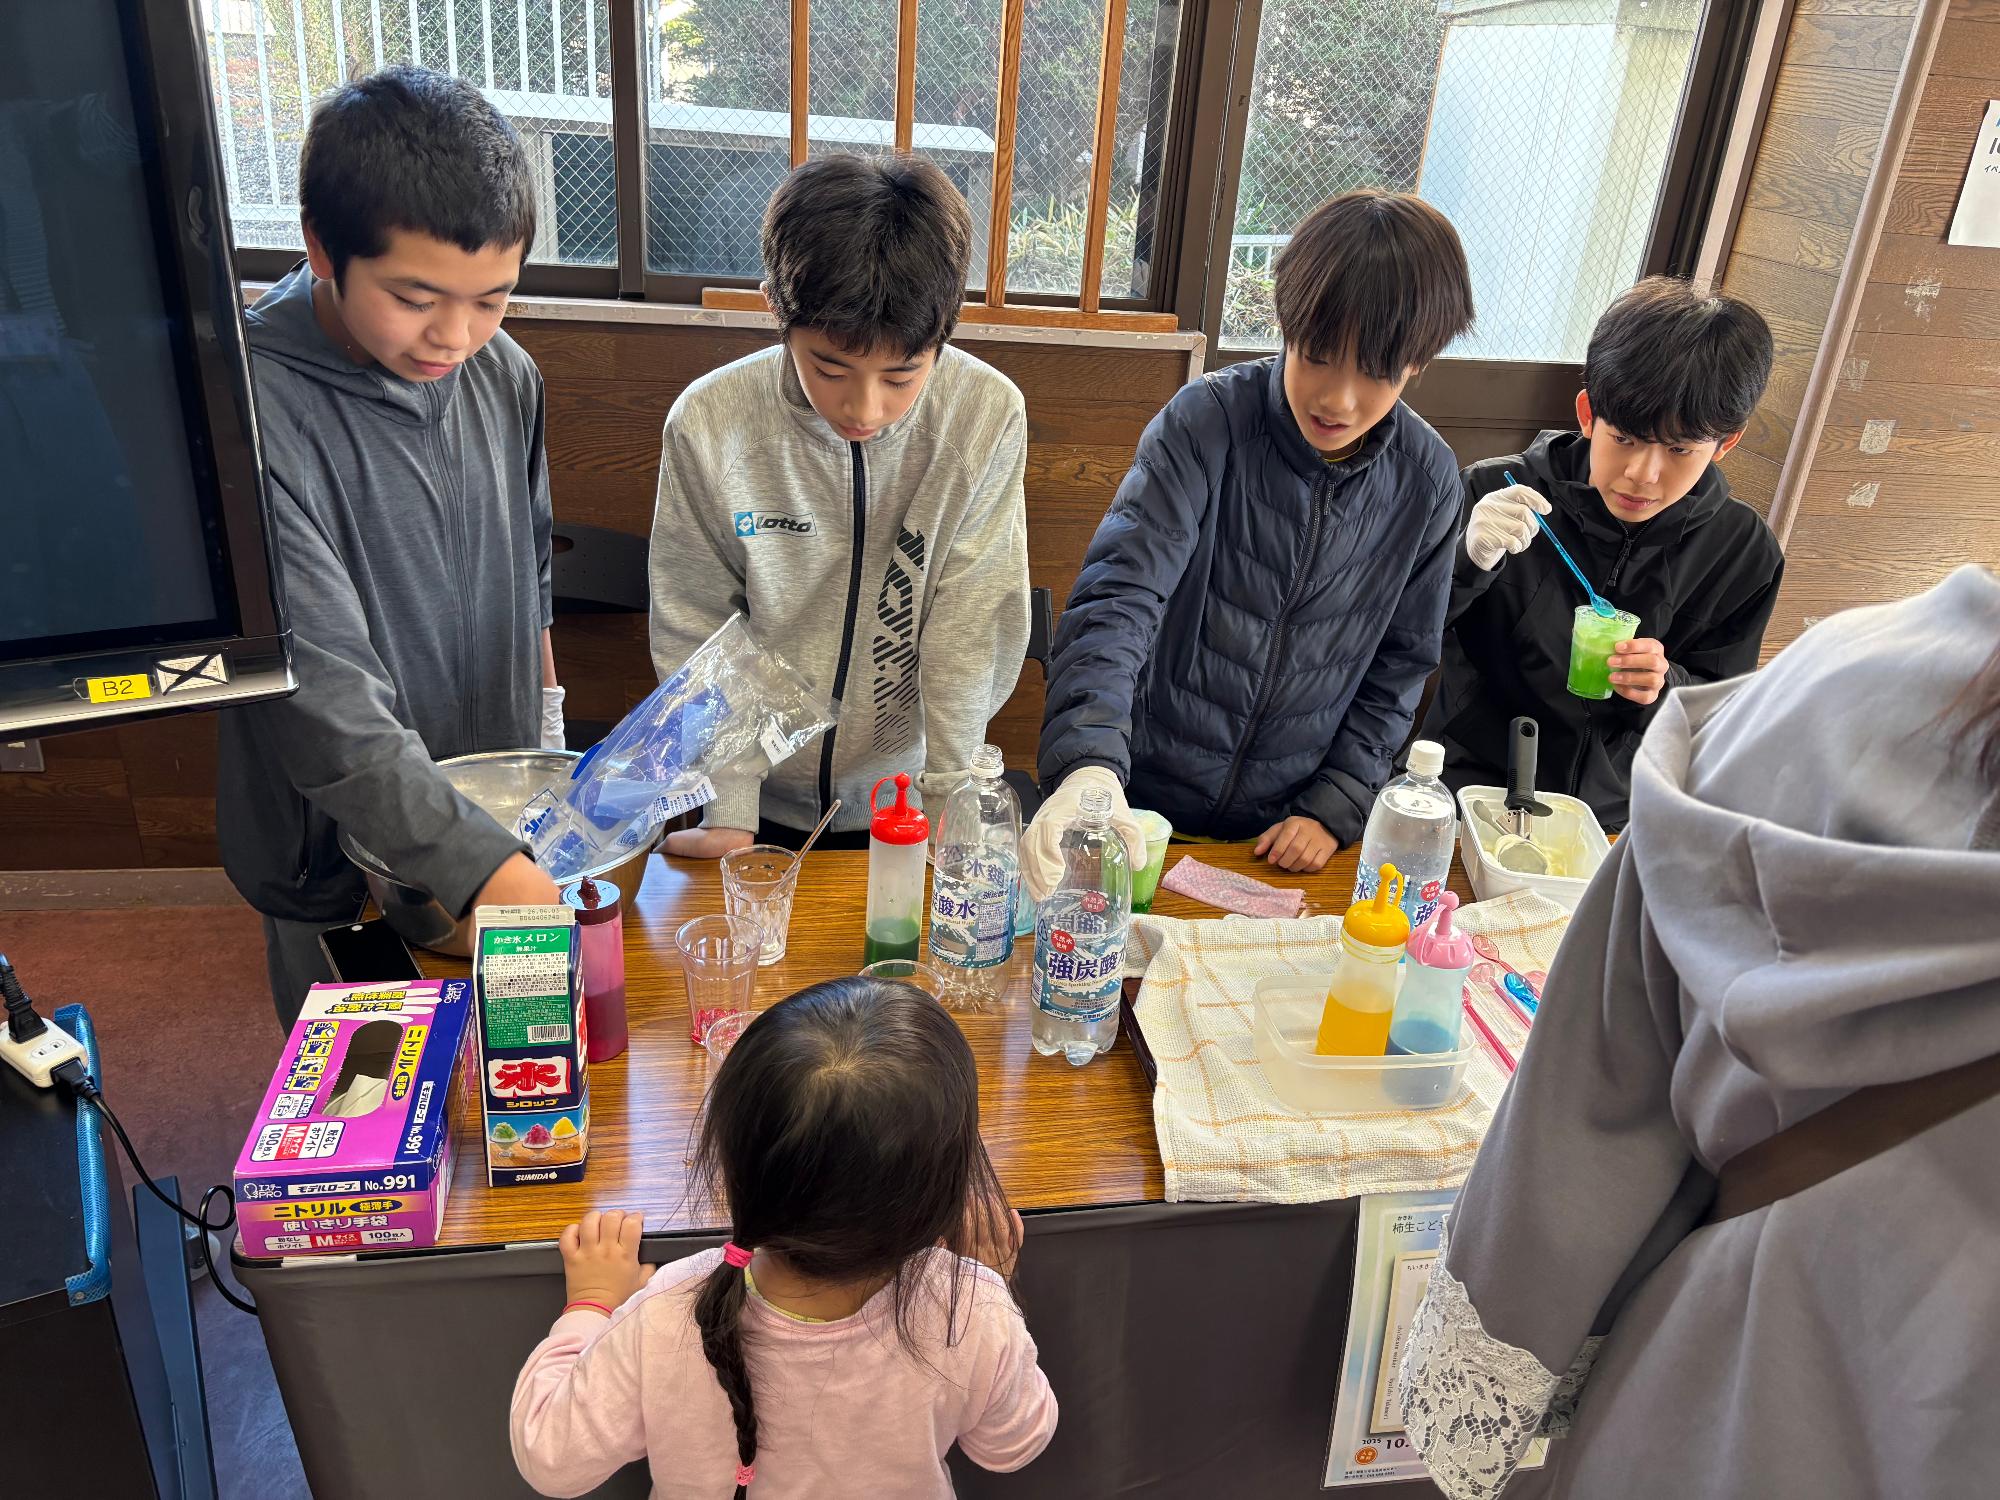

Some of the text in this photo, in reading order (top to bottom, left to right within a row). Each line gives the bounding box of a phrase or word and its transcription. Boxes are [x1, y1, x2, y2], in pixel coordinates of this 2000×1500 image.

[1985, 165, 2000, 173] イベ
[103, 679, 134, 696] B2
[1053, 933, 1072, 944] 天然水
[399, 1029, 422, 1069] ニトリル
[495, 1061, 561, 1091] 氷
[506, 1098, 559, 1108] シロップ
[306, 1127, 322, 1152] ホワイト
[405, 1125, 421, 1154] No.991
[365, 1174, 416, 1191] No.991
[515, 1173, 549, 1181] SUMIDA
[259, 1190, 282, 1198] PRO
[274, 1199, 393, 1218] ニトリル 極薄手
[283, 1215, 388, 1232] 使いきり手袋
